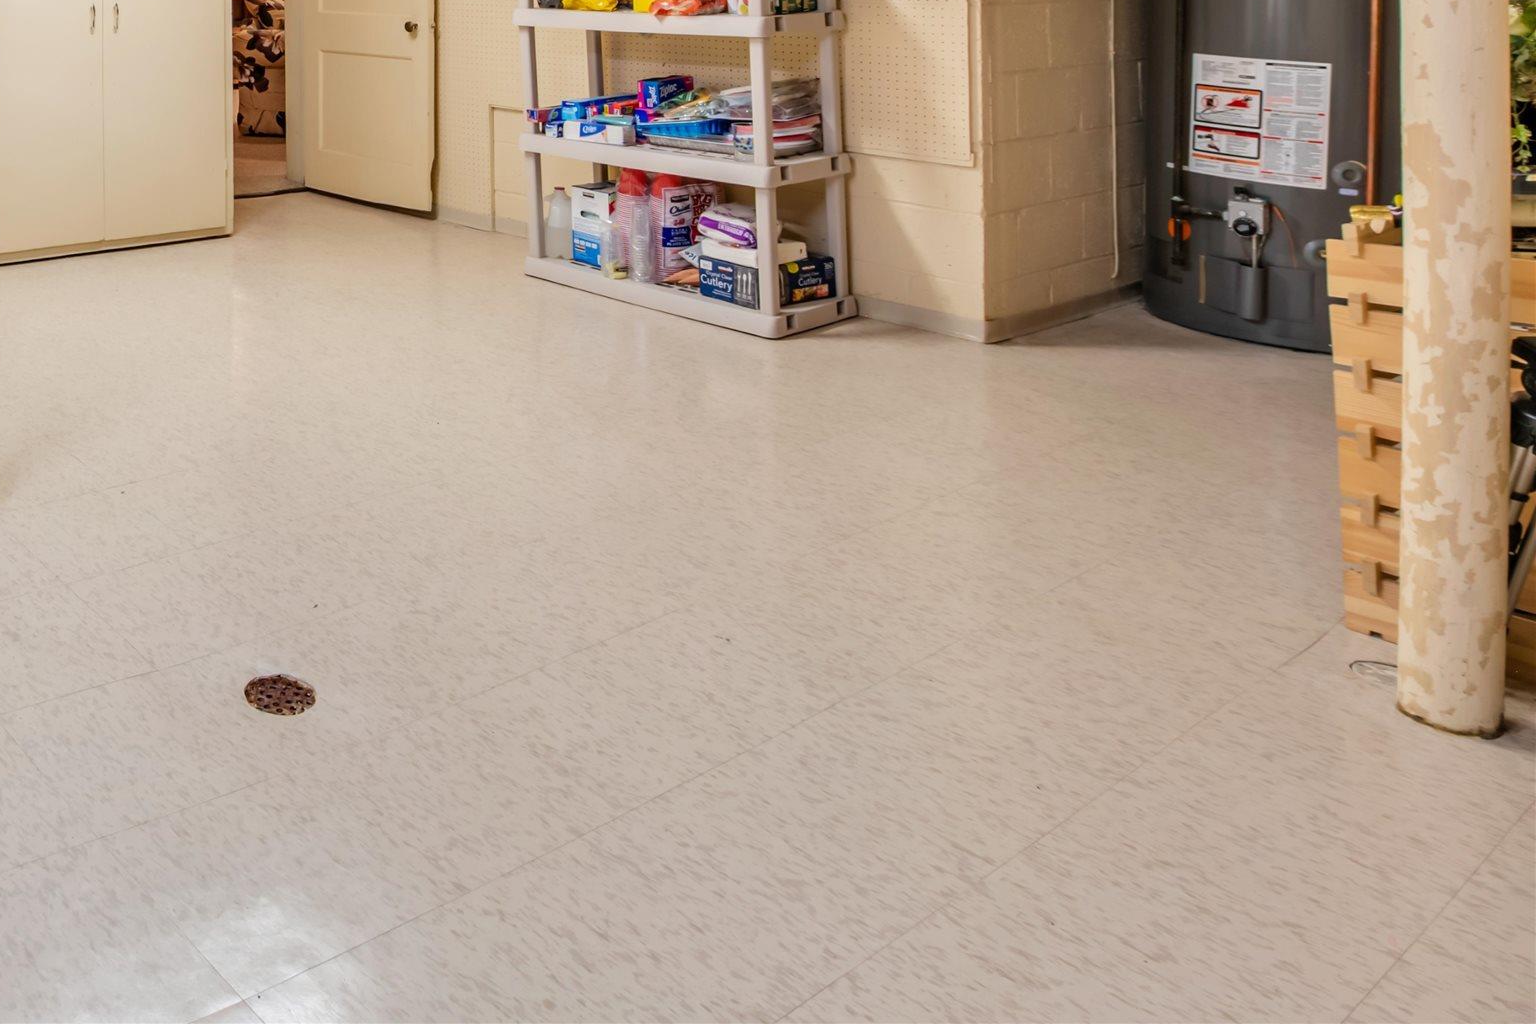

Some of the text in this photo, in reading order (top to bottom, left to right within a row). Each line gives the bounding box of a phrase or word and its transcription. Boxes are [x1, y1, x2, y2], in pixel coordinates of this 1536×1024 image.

[659, 83, 678, 98] Ziploc
[700, 273, 733, 292] Cutlery
[797, 276, 822, 287] Cutlery
